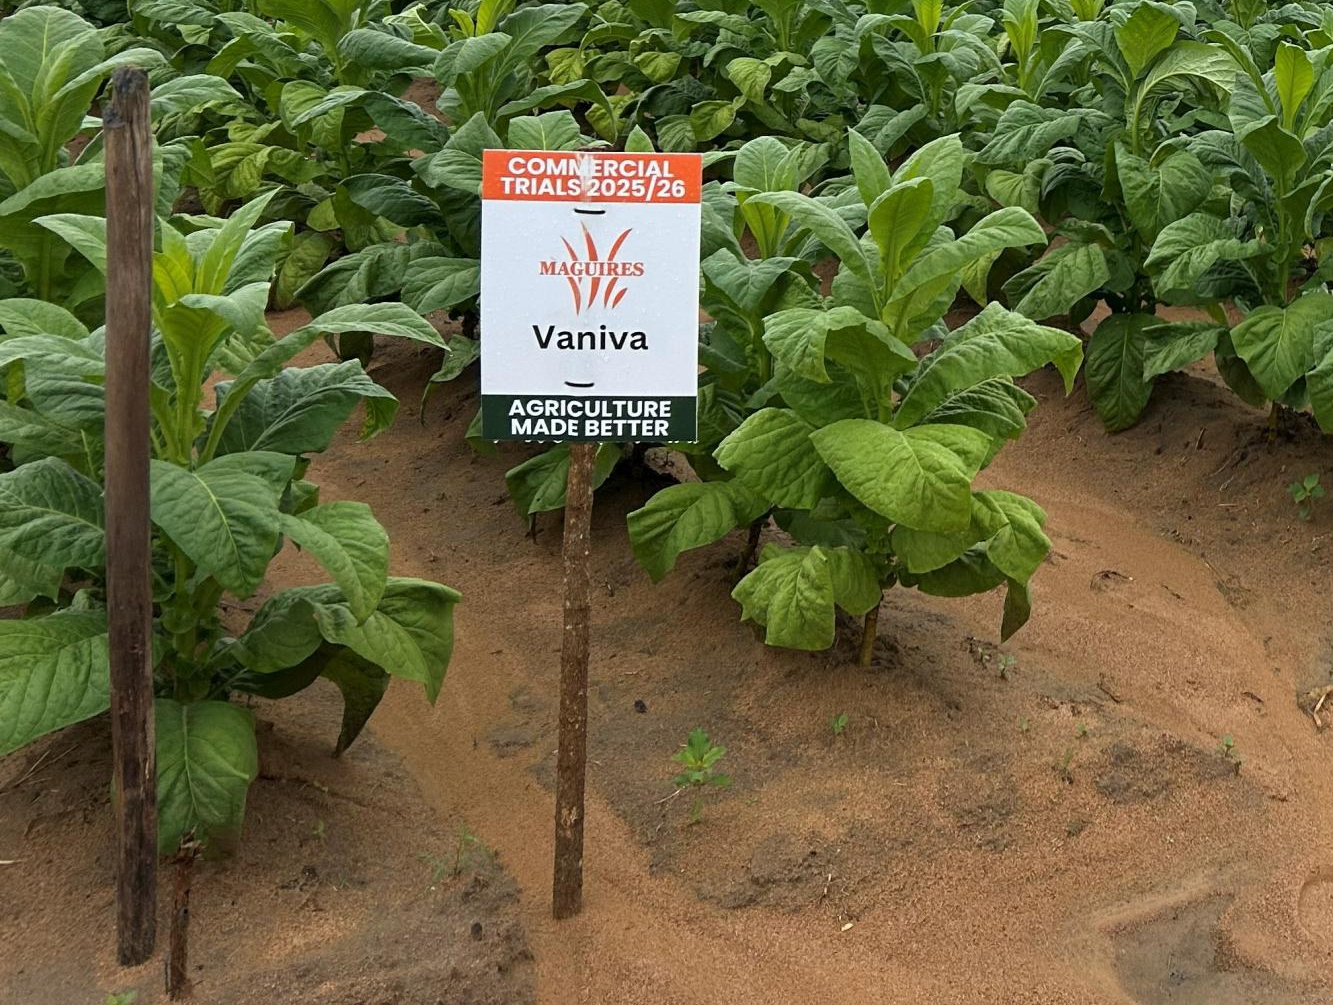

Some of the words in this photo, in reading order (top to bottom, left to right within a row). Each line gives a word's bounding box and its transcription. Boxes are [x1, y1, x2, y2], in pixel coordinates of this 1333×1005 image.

[508, 157, 674, 178] COMMERCIAL
[501, 177, 581, 197] TRIALS
[587, 176, 686, 201] 2025/26
[540, 261, 645, 277] MAGUIRES
[533, 324, 649, 351] Vaniva
[509, 400, 671, 419] AGRICULTURE
[512, 419, 579, 436] MADE
[584, 419, 669, 437] BETTER
